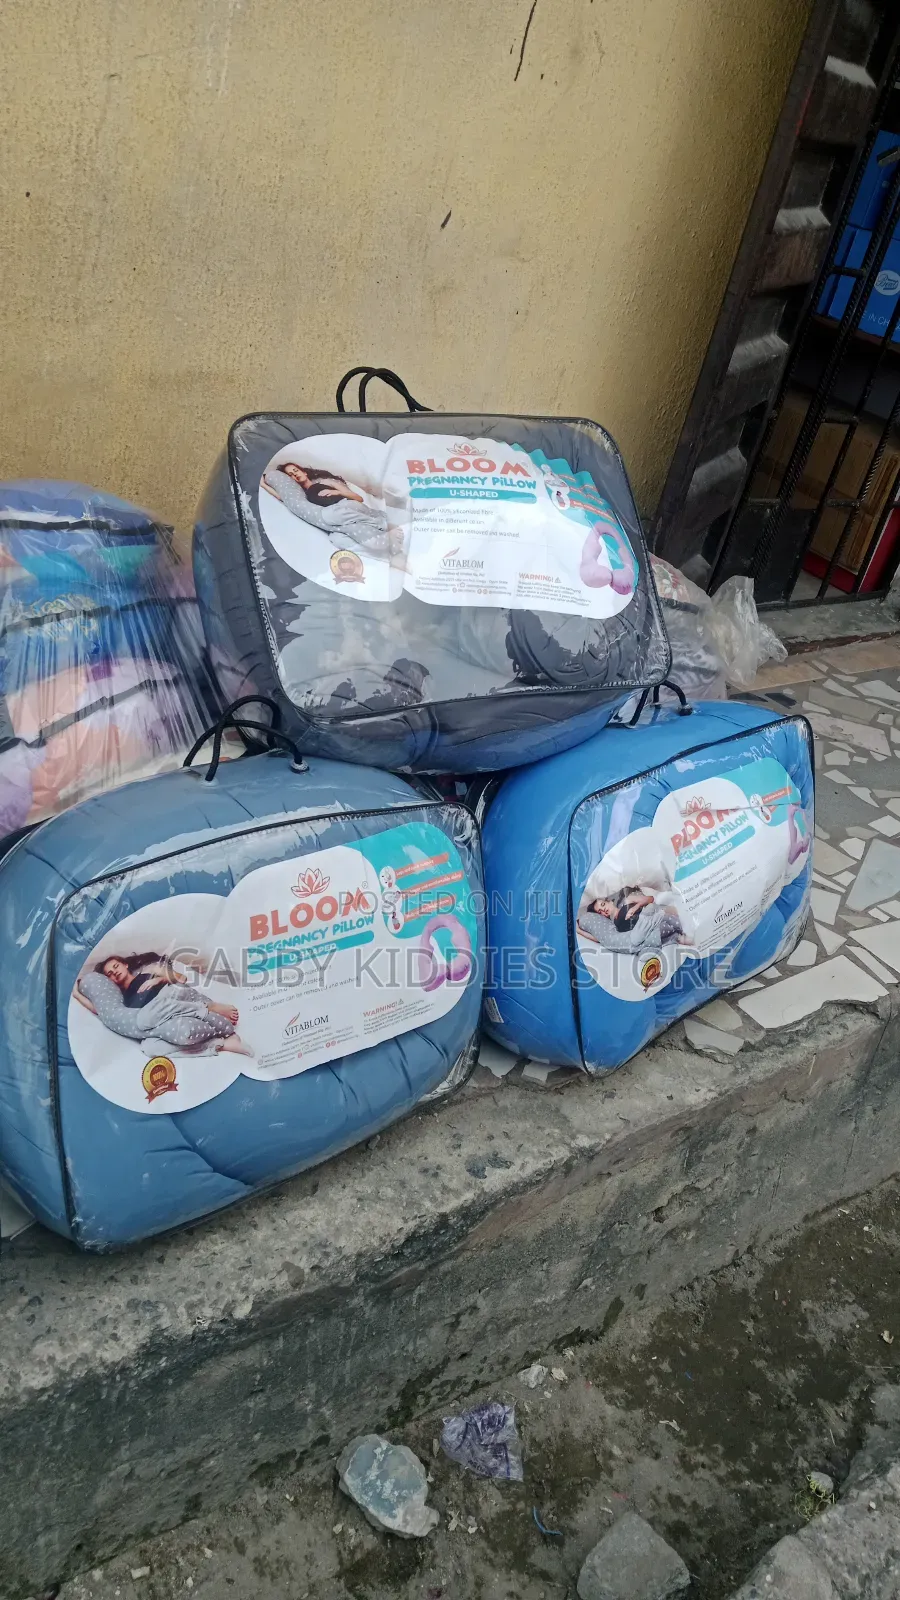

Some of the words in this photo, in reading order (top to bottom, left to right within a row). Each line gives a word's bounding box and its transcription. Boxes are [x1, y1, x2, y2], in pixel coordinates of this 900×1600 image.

[406, 457, 531, 478] BLOOM
[407, 476, 488, 487] PREGNANCY
[449, 489, 499, 498] U-SHAPED
[442, 559, 484, 569] VITABLOM
[702, 842, 733, 865] U-SHAPED
[250, 887, 370, 941] BLOOM
[248, 927, 328, 958] PREGNANCY
[285, 1015, 329, 1037] VITABLOM
